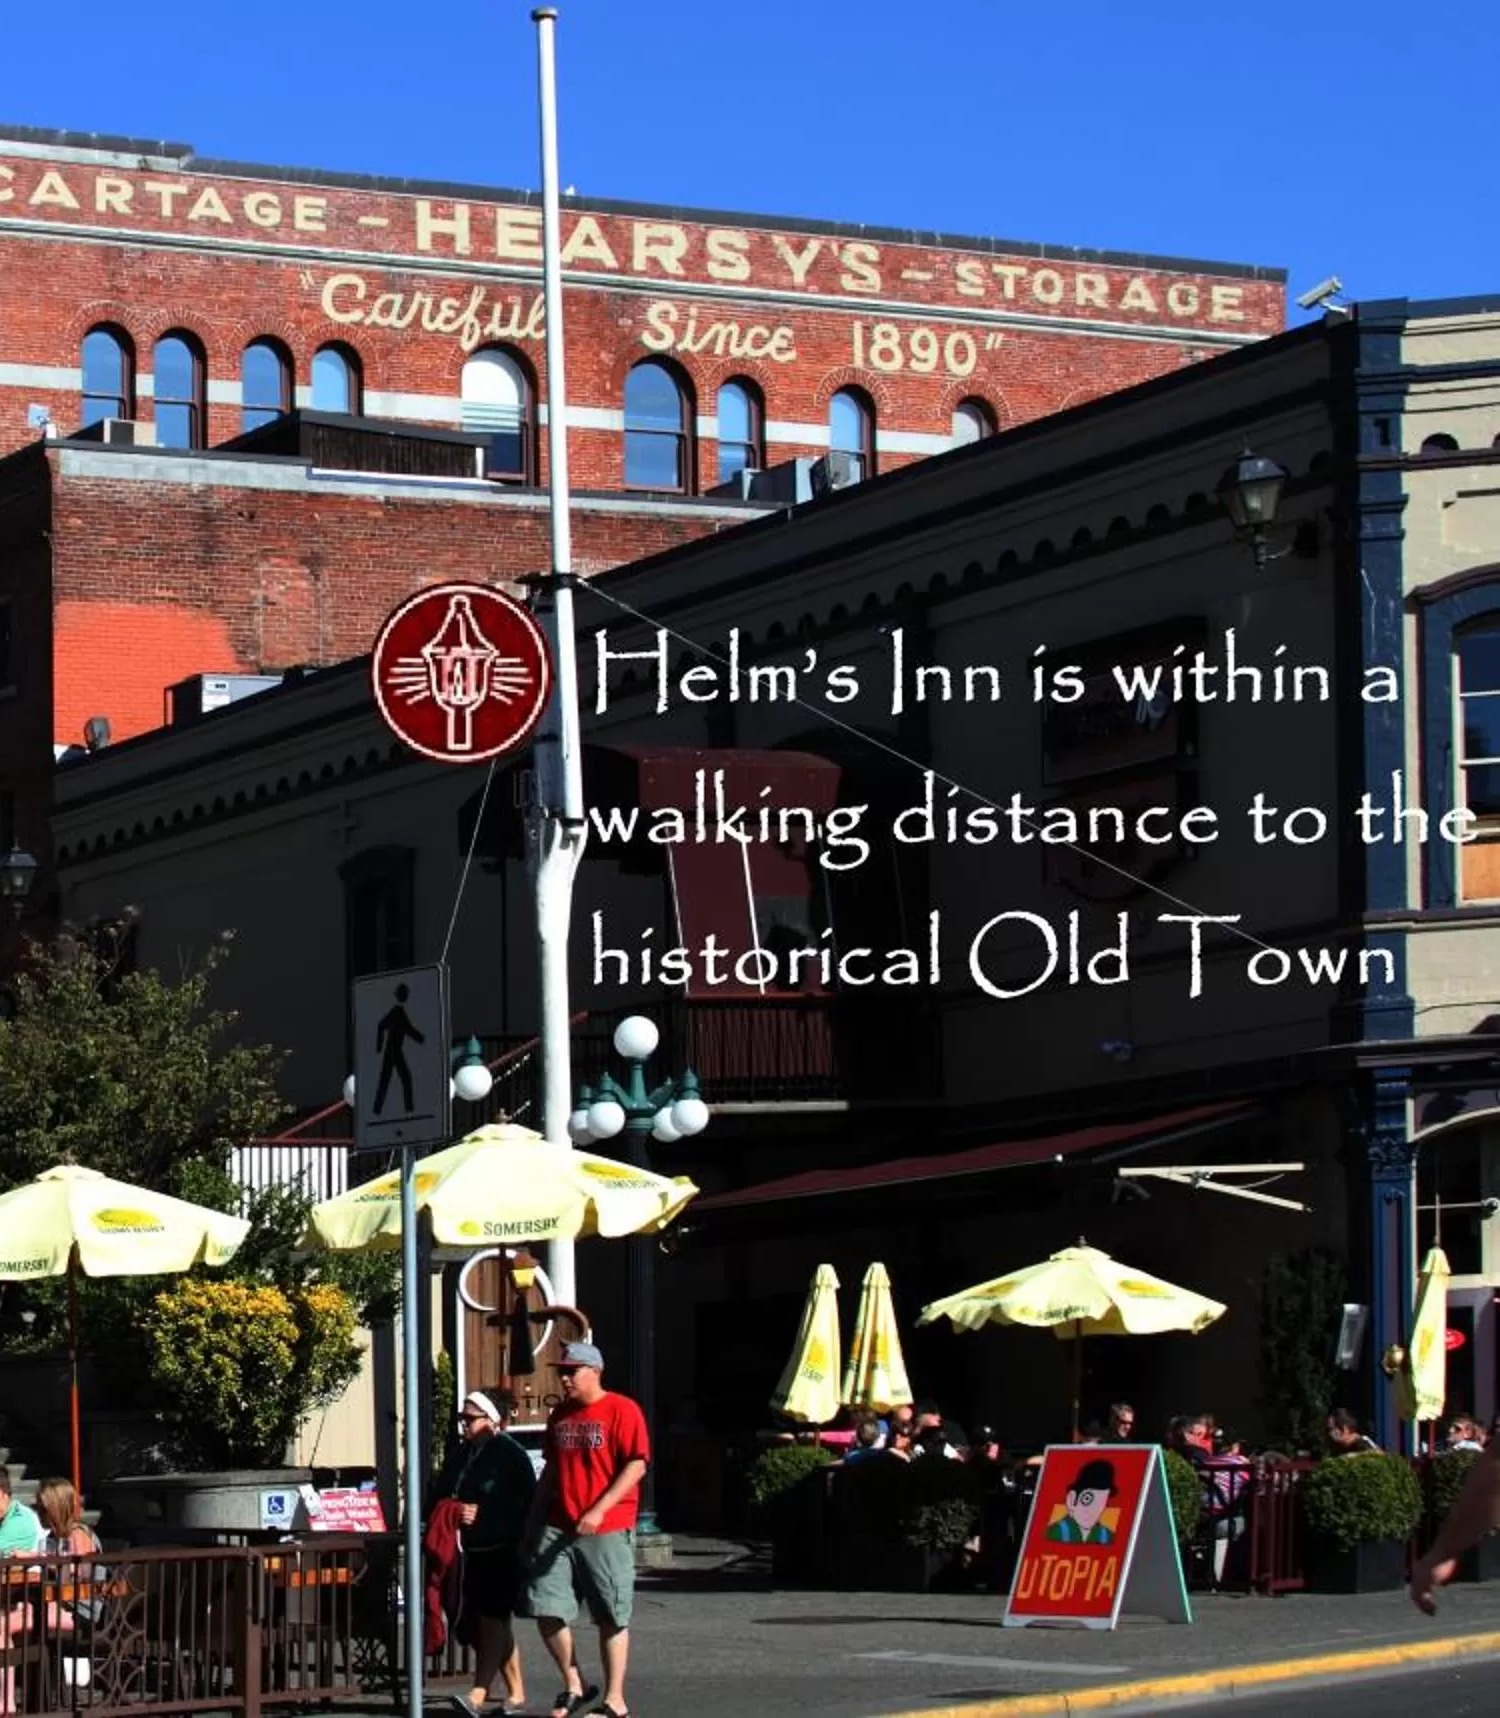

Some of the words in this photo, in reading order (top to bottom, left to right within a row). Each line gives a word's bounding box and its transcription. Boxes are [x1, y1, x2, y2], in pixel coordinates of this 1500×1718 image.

[415, 200, 881, 294] HEARSY'S
[956, 259, 1245, 321] STORAGE
[641, 299, 797, 363] Since
[483, 1216, 561, 1236] SOMERSBY
[1015, 1554, 1117, 1601] UTOPIA
